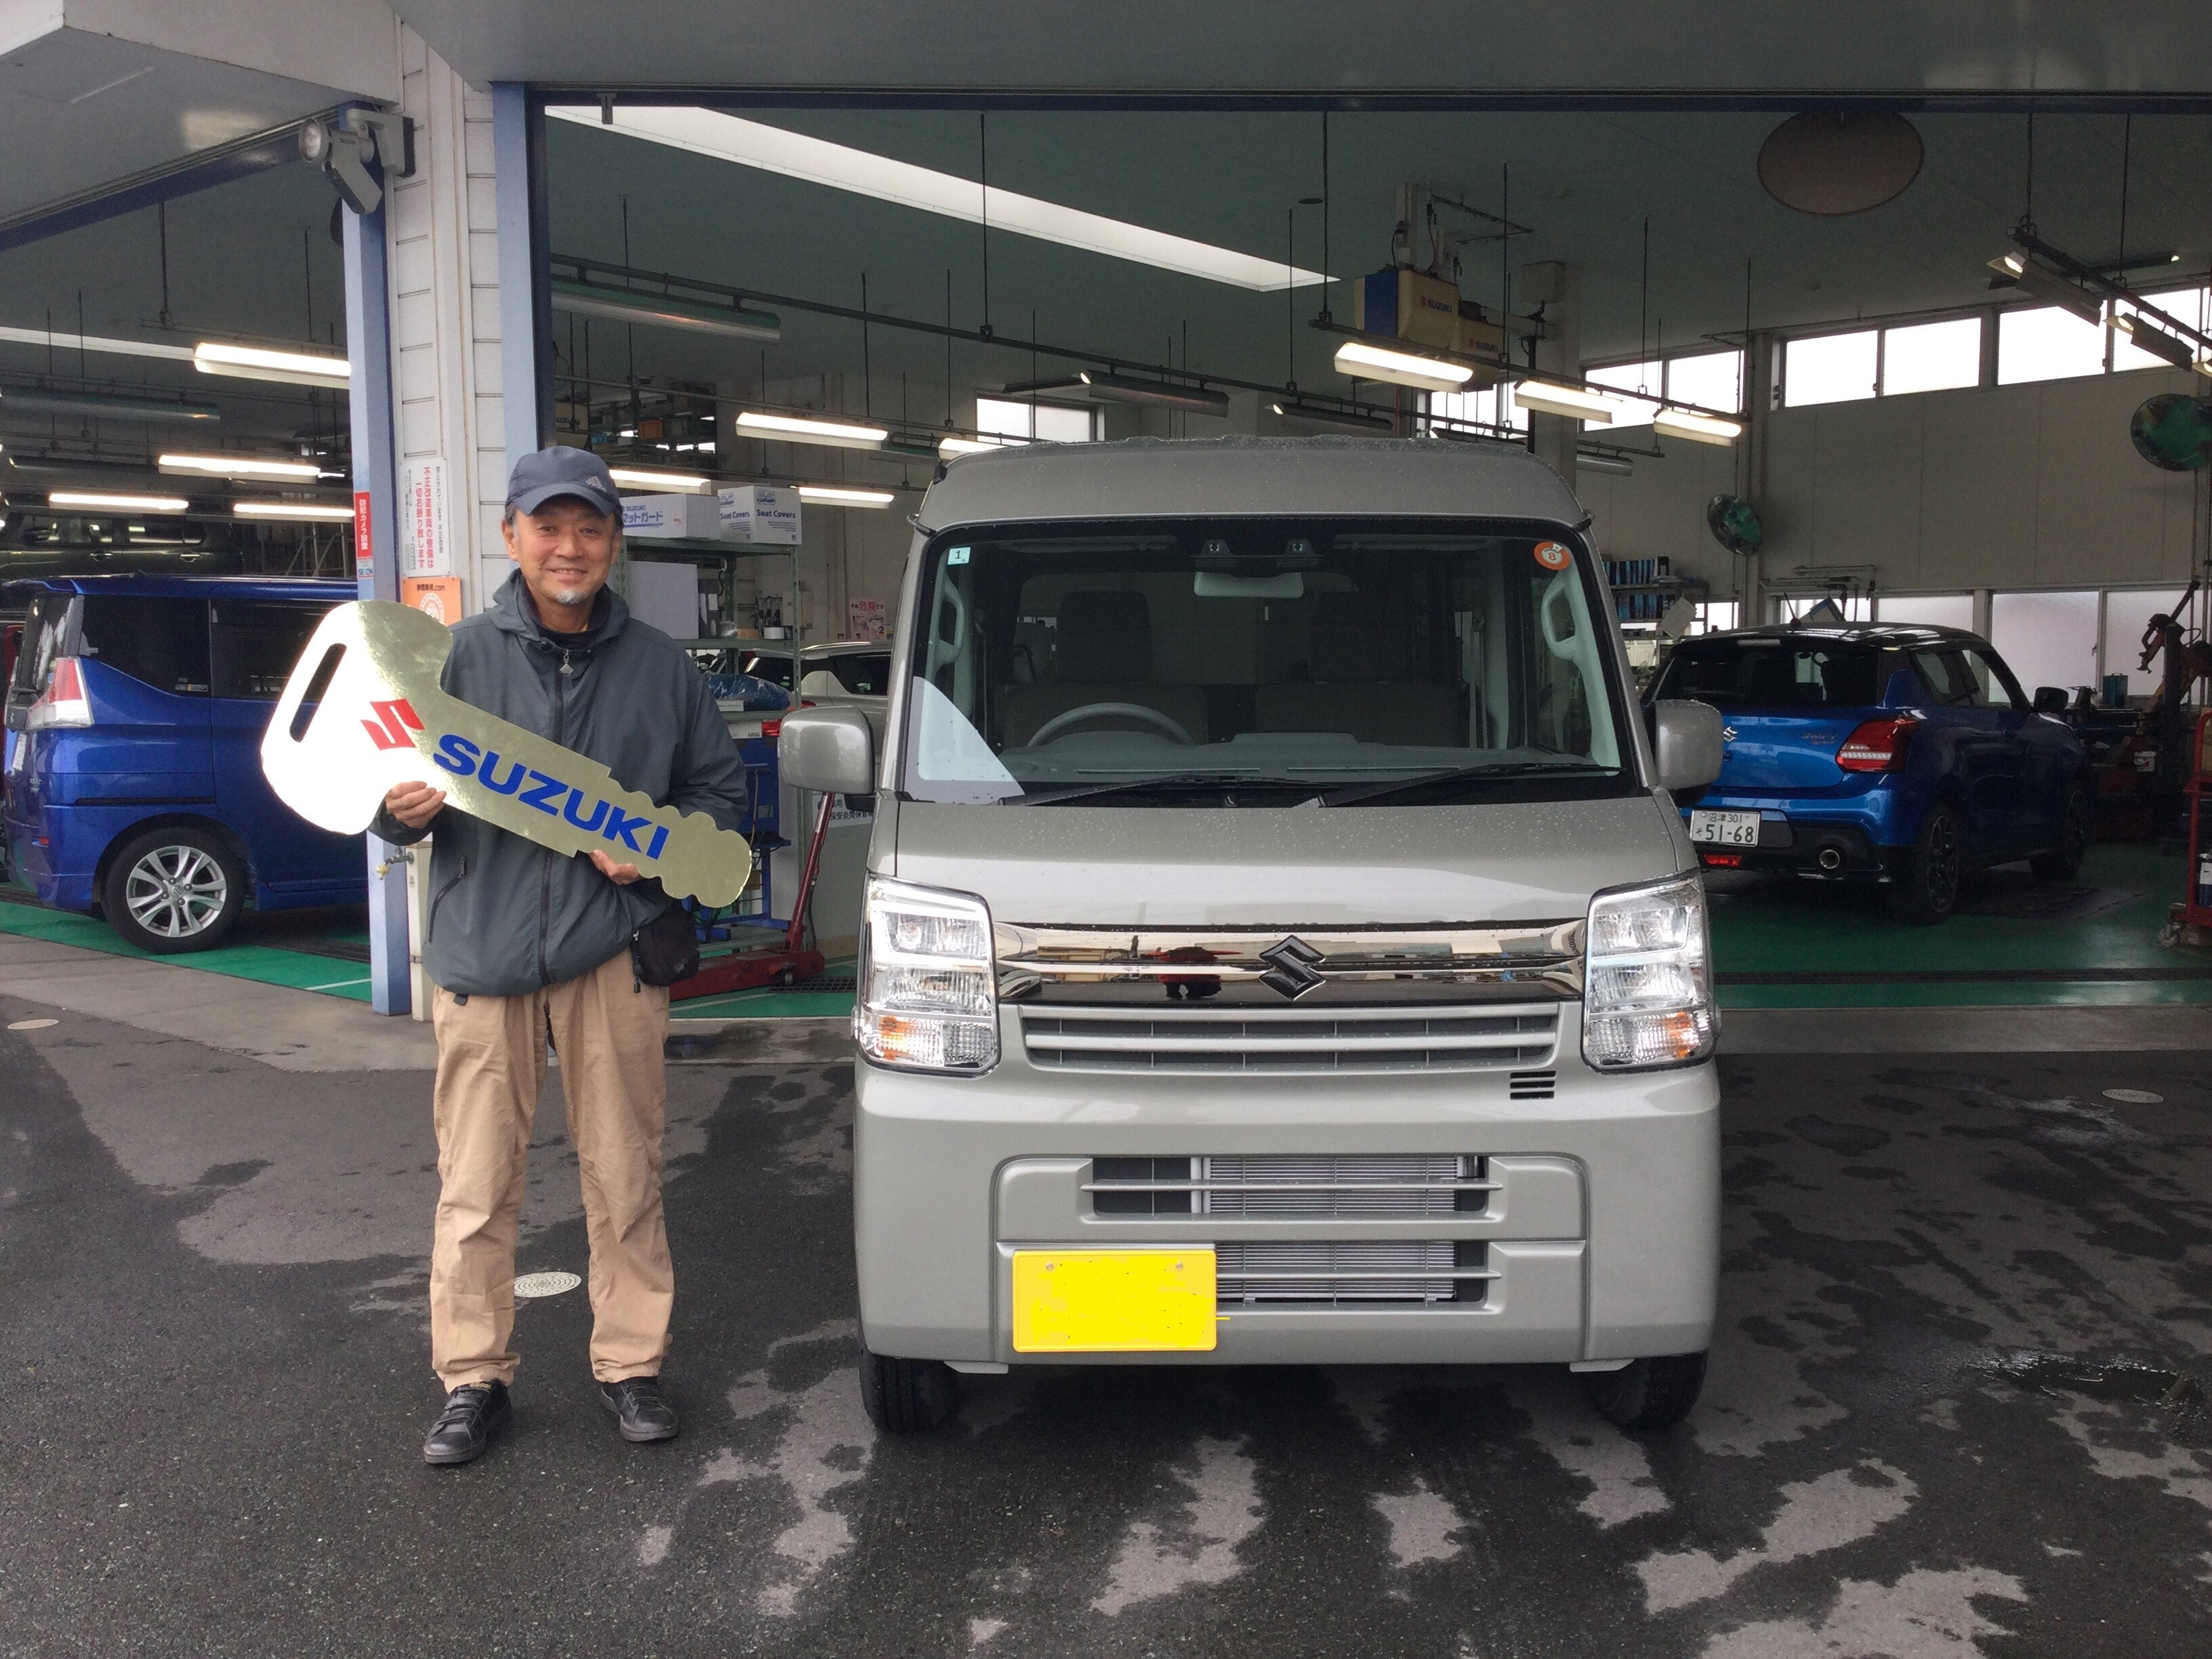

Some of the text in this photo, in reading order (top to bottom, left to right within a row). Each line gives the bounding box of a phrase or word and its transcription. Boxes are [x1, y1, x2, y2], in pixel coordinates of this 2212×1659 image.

[1427, 299, 1452, 312] SUZUKI
[424, 466, 434, 569] 不正改造車両の整備は
[622, 510, 663, 524] マットガード
[732, 511, 750, 519] Covers
[756, 509, 796, 518] Seat Covers
[359, 499, 369, 550] 防犯カメラ設置
[415, 482, 424, 569] 一切お断り致します
[955, 550, 961, 560] 1
[878, 626, 884, 634] 2
[432, 734, 670, 861] SUZUKI
[1708, 813, 1742, 823] 沼津 301
[1705, 824, 1754, 843] 51-68
